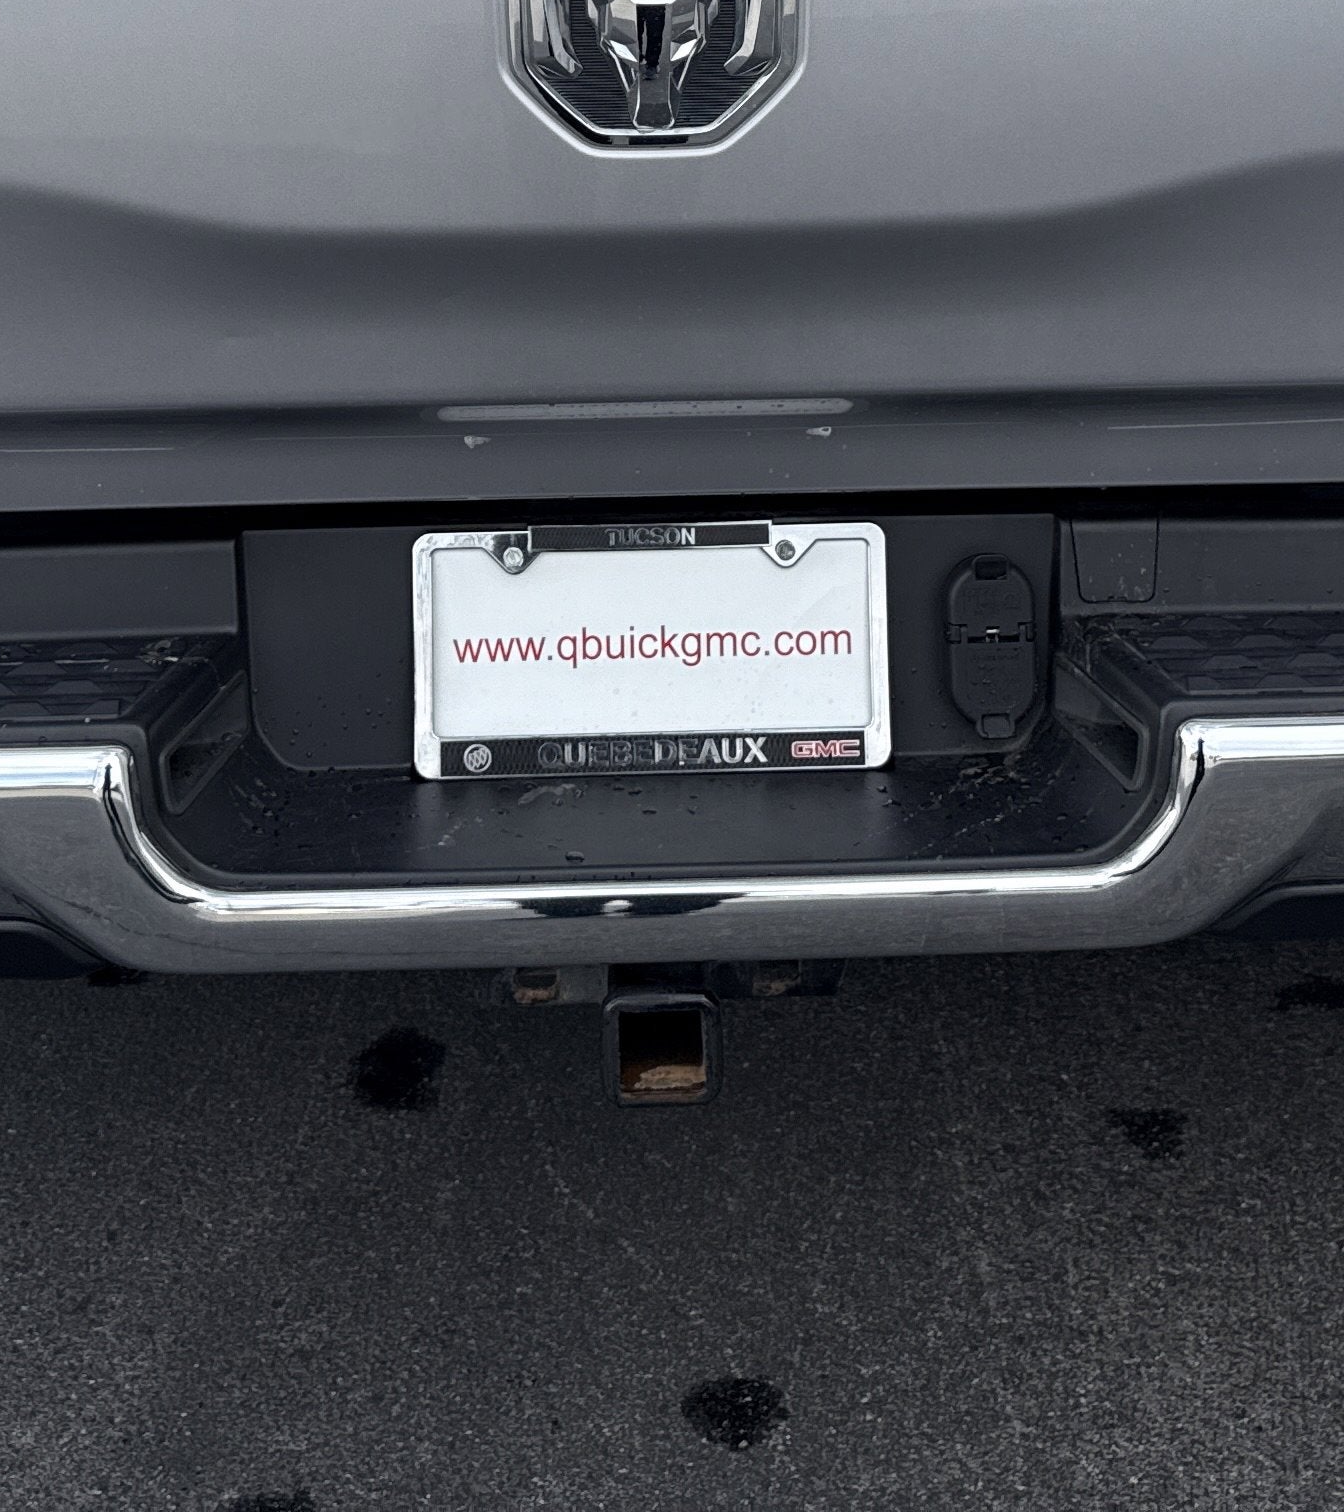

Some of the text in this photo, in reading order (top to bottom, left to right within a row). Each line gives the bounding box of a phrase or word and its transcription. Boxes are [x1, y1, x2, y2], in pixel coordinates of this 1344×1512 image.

[604, 527, 696, 546] TUCSON
[453, 625, 853, 669] www.qbuickgmc.com
[538, 737, 860, 767] QUEBEDEAUX GMC
